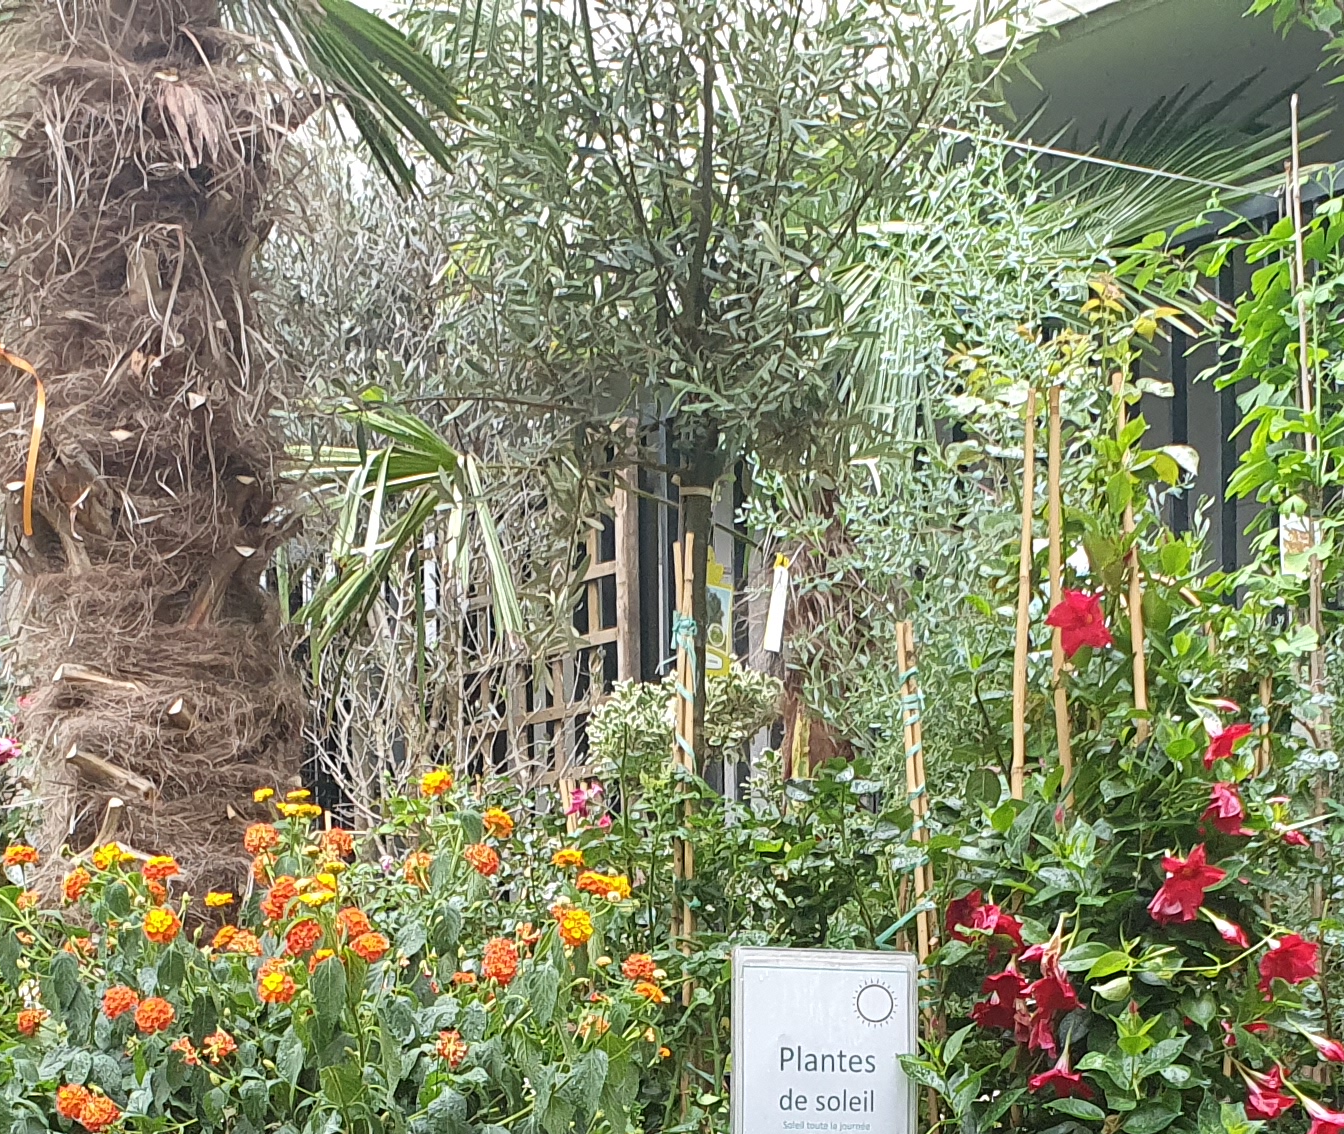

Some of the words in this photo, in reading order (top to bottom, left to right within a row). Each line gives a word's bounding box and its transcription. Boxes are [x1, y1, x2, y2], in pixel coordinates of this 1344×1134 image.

[780, 1045, 876, 1073] Plantes
[779, 1088, 808, 1111] de
[815, 1088, 874, 1112] soleil
[783, 1120, 804, 1130] Soleil
[806, 1121, 828, 1130] toute
[830, 1122, 838, 1130] la
[839, 1122, 871, 1131] journée
